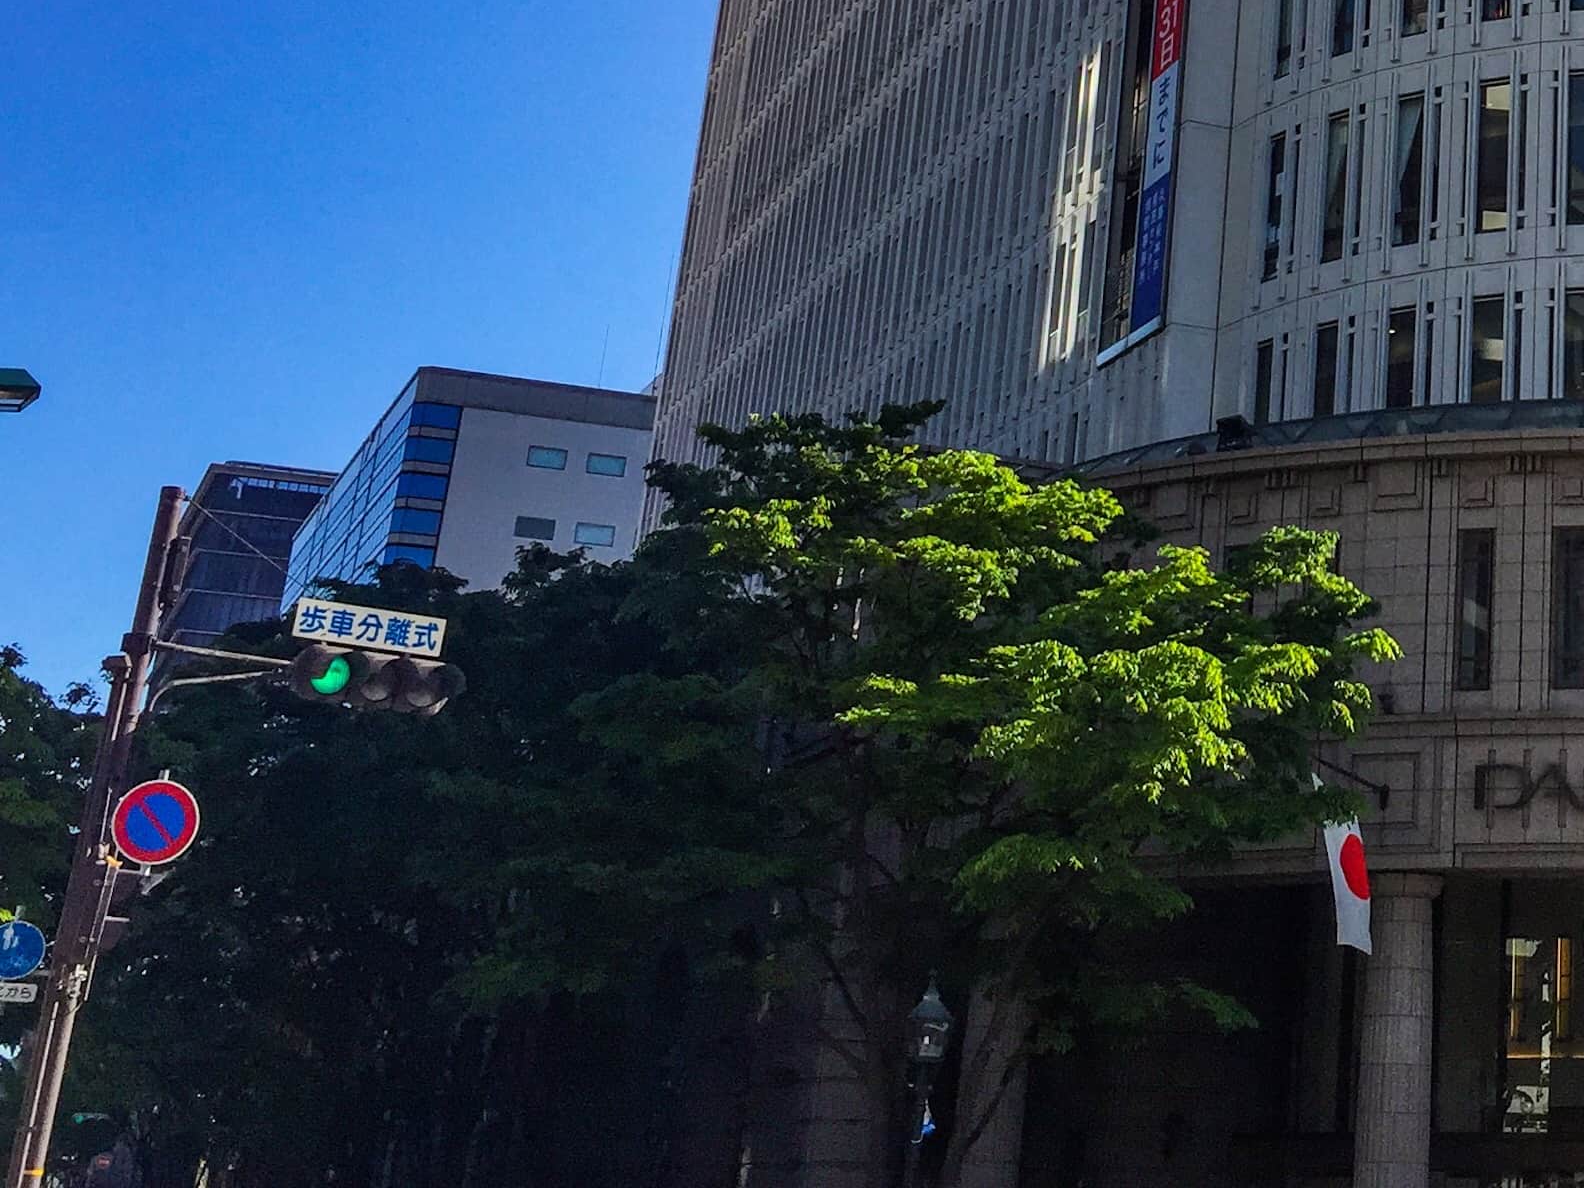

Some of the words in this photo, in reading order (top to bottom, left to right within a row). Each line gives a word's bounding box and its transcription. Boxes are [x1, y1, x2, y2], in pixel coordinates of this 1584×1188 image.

[300, 605, 440, 650] 歩車分離式
